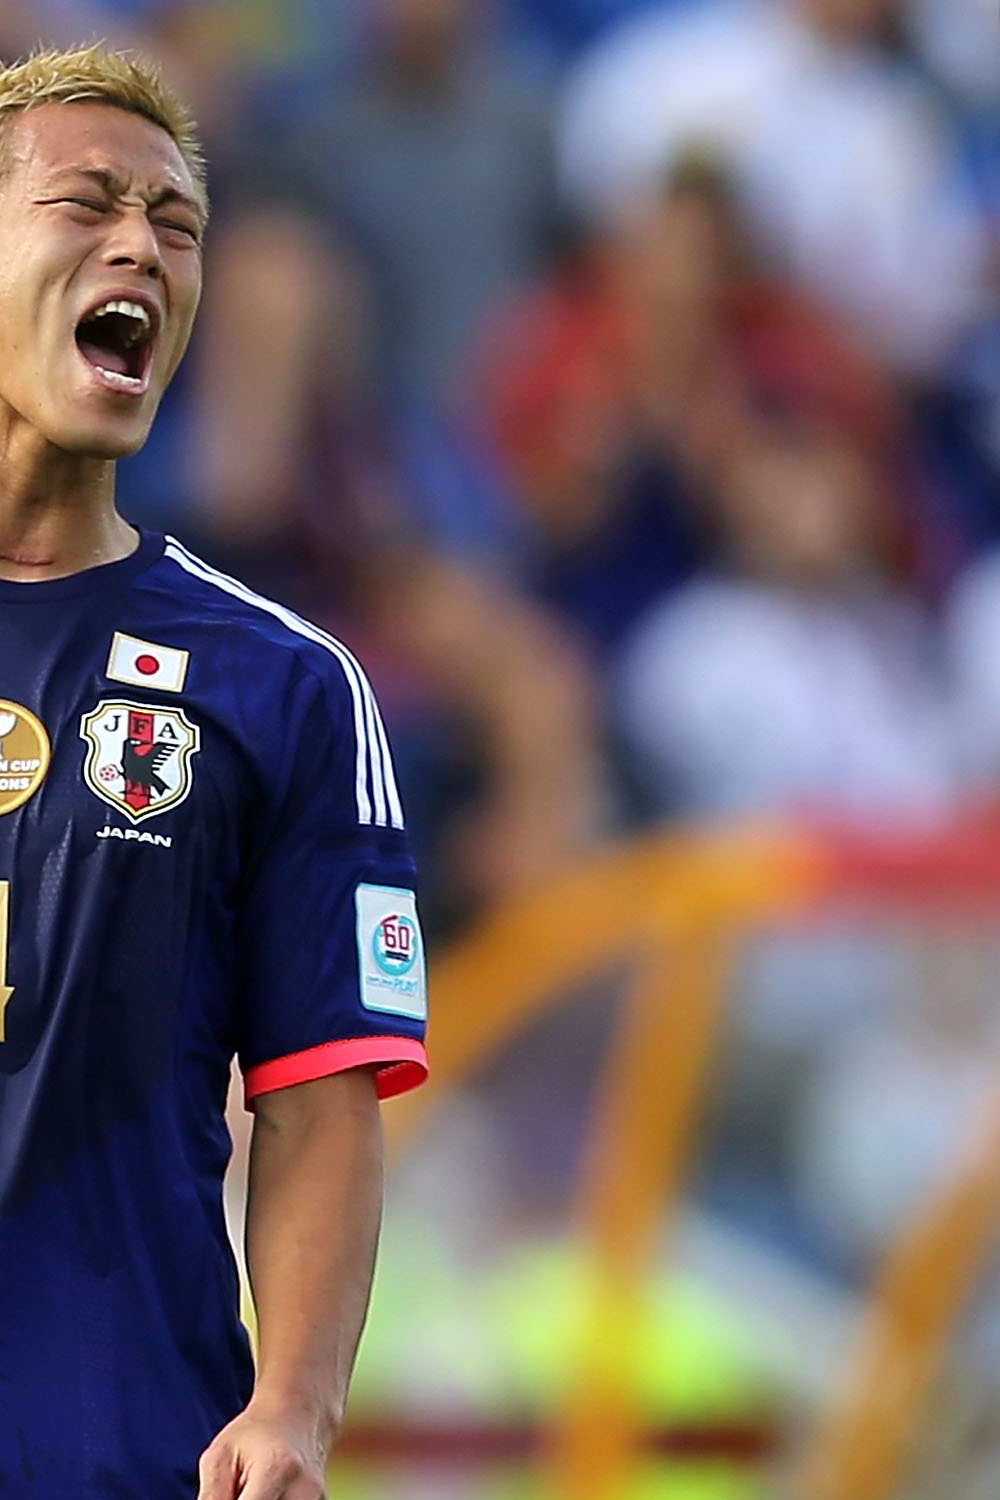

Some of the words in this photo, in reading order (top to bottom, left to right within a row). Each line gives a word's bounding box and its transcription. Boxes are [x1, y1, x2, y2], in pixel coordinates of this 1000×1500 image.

[10, 759, 41, 772] CUP
[96, 826, 173, 848] JAPAN
[383, 923, 411, 951] 60
